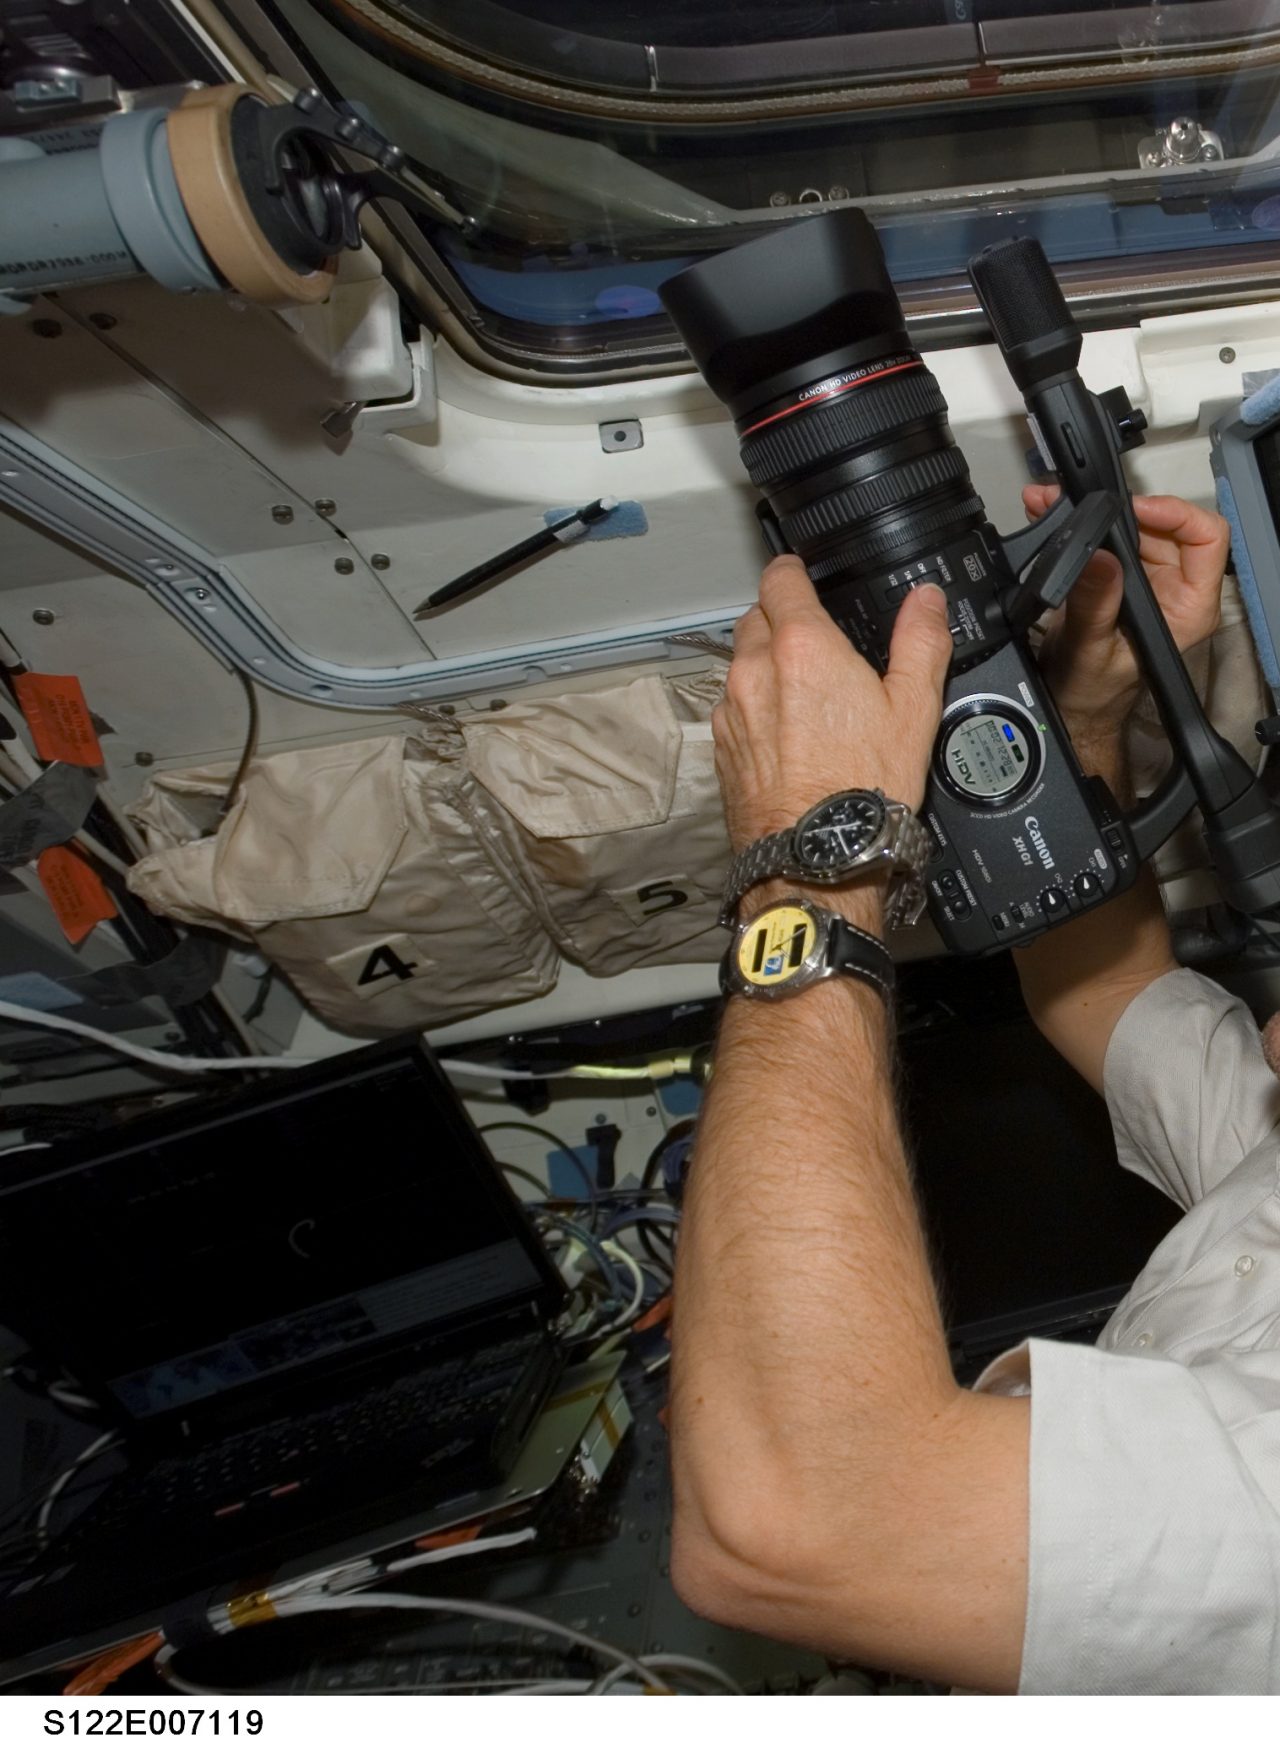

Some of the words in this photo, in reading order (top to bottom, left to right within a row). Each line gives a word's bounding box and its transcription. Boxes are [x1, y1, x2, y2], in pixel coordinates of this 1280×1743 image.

[799, 385, 828, 401] CANON
[829, 379, 842, 391] HD
[843, 369, 867, 384] VIDEO
[868, 362, 885, 375] LENS
[951, 747, 976, 785] HDV
[993, 811, 1008, 819] VIDEO
[1008, 802, 1028, 815] CAMERA
[972, 849, 984, 866] HDV
[1024, 816, 1056, 870] Canon
[637, 881, 689, 917] 5
[357, 944, 419, 987] 4
